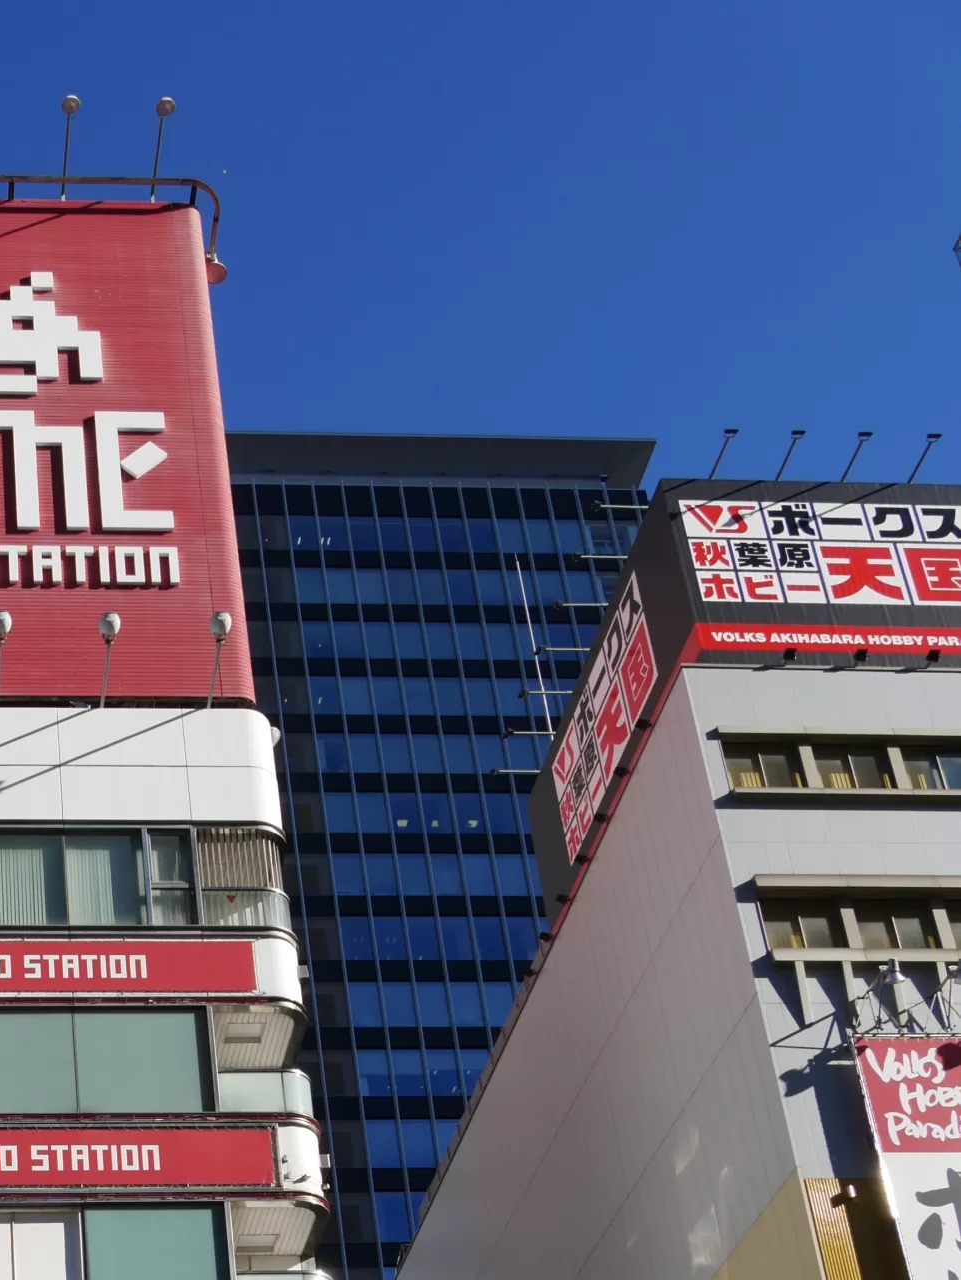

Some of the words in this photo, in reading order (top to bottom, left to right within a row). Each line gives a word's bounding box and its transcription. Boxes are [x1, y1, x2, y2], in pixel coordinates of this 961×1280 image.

[771, 504, 961, 540] ボークス
[692, 542, 815, 569] 秋葉原
[702, 574, 821, 601] ホビー
[821, 547, 961, 602] 天国
[711, 632, 767, 643] VOLKS
[770, 633, 865, 645] AKIHABARA
[867, 635, 923, 646] HOBBY
[926, 636, 961, 646] PAR
[24, 954, 148, 979] STATION
[884, 1111, 961, 1146] Parad
[31, 1145, 161, 1172] STATION
